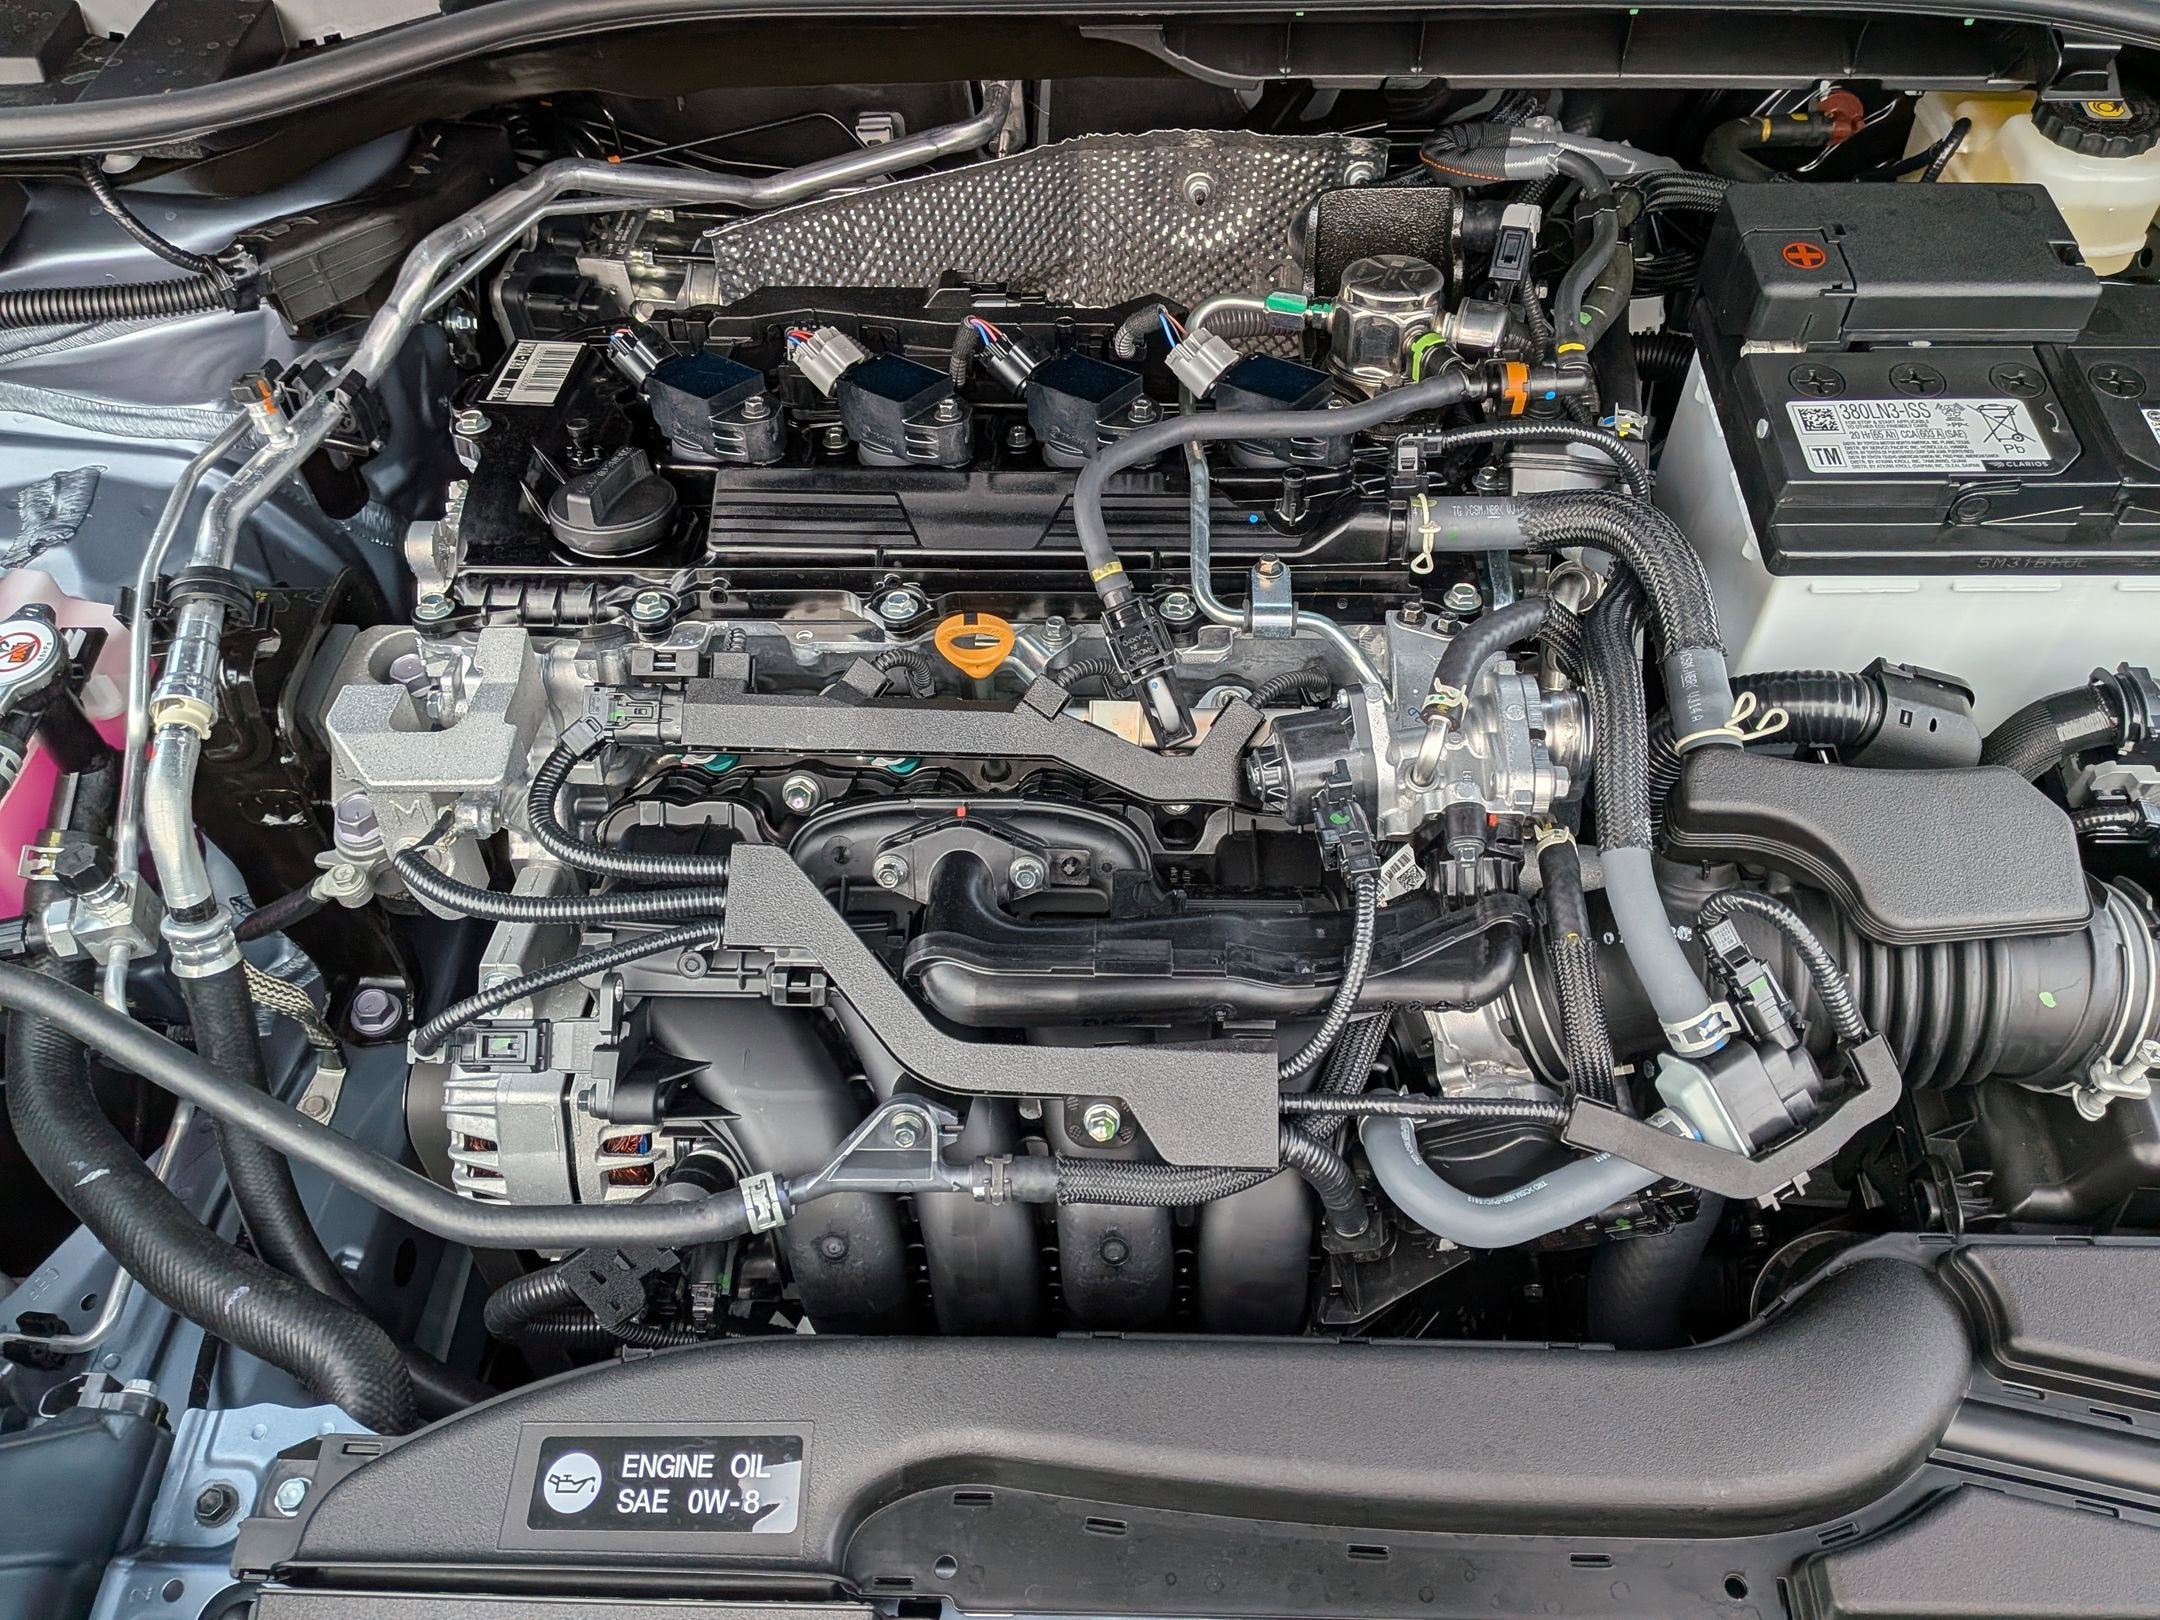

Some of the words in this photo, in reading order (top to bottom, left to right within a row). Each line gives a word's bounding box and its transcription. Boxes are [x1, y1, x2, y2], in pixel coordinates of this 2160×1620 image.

[1840, 402, 1932, 420] 380LN3-ISS
[1848, 431, 1861, 440] 20
[1861, 431, 1871, 440] Hr
[1873, 431, 1884, 439] 65
[1885, 430, 1897, 439] Ah
[1900, 430, 1918, 439] CCA
[1919, 430, 1935, 438] 603
[1936, 430, 1943, 438] A
[1945, 430, 1968, 440] (SAE)
[1811, 448, 1843, 465] TM
[2003, 443, 2026, 454] Pb
[621, 1454, 716, 1479] ENGINE
[730, 1454, 772, 1480] OIL
[616, 1488, 671, 1514] SAE
[687, 1488, 761, 1514] 0W-8
